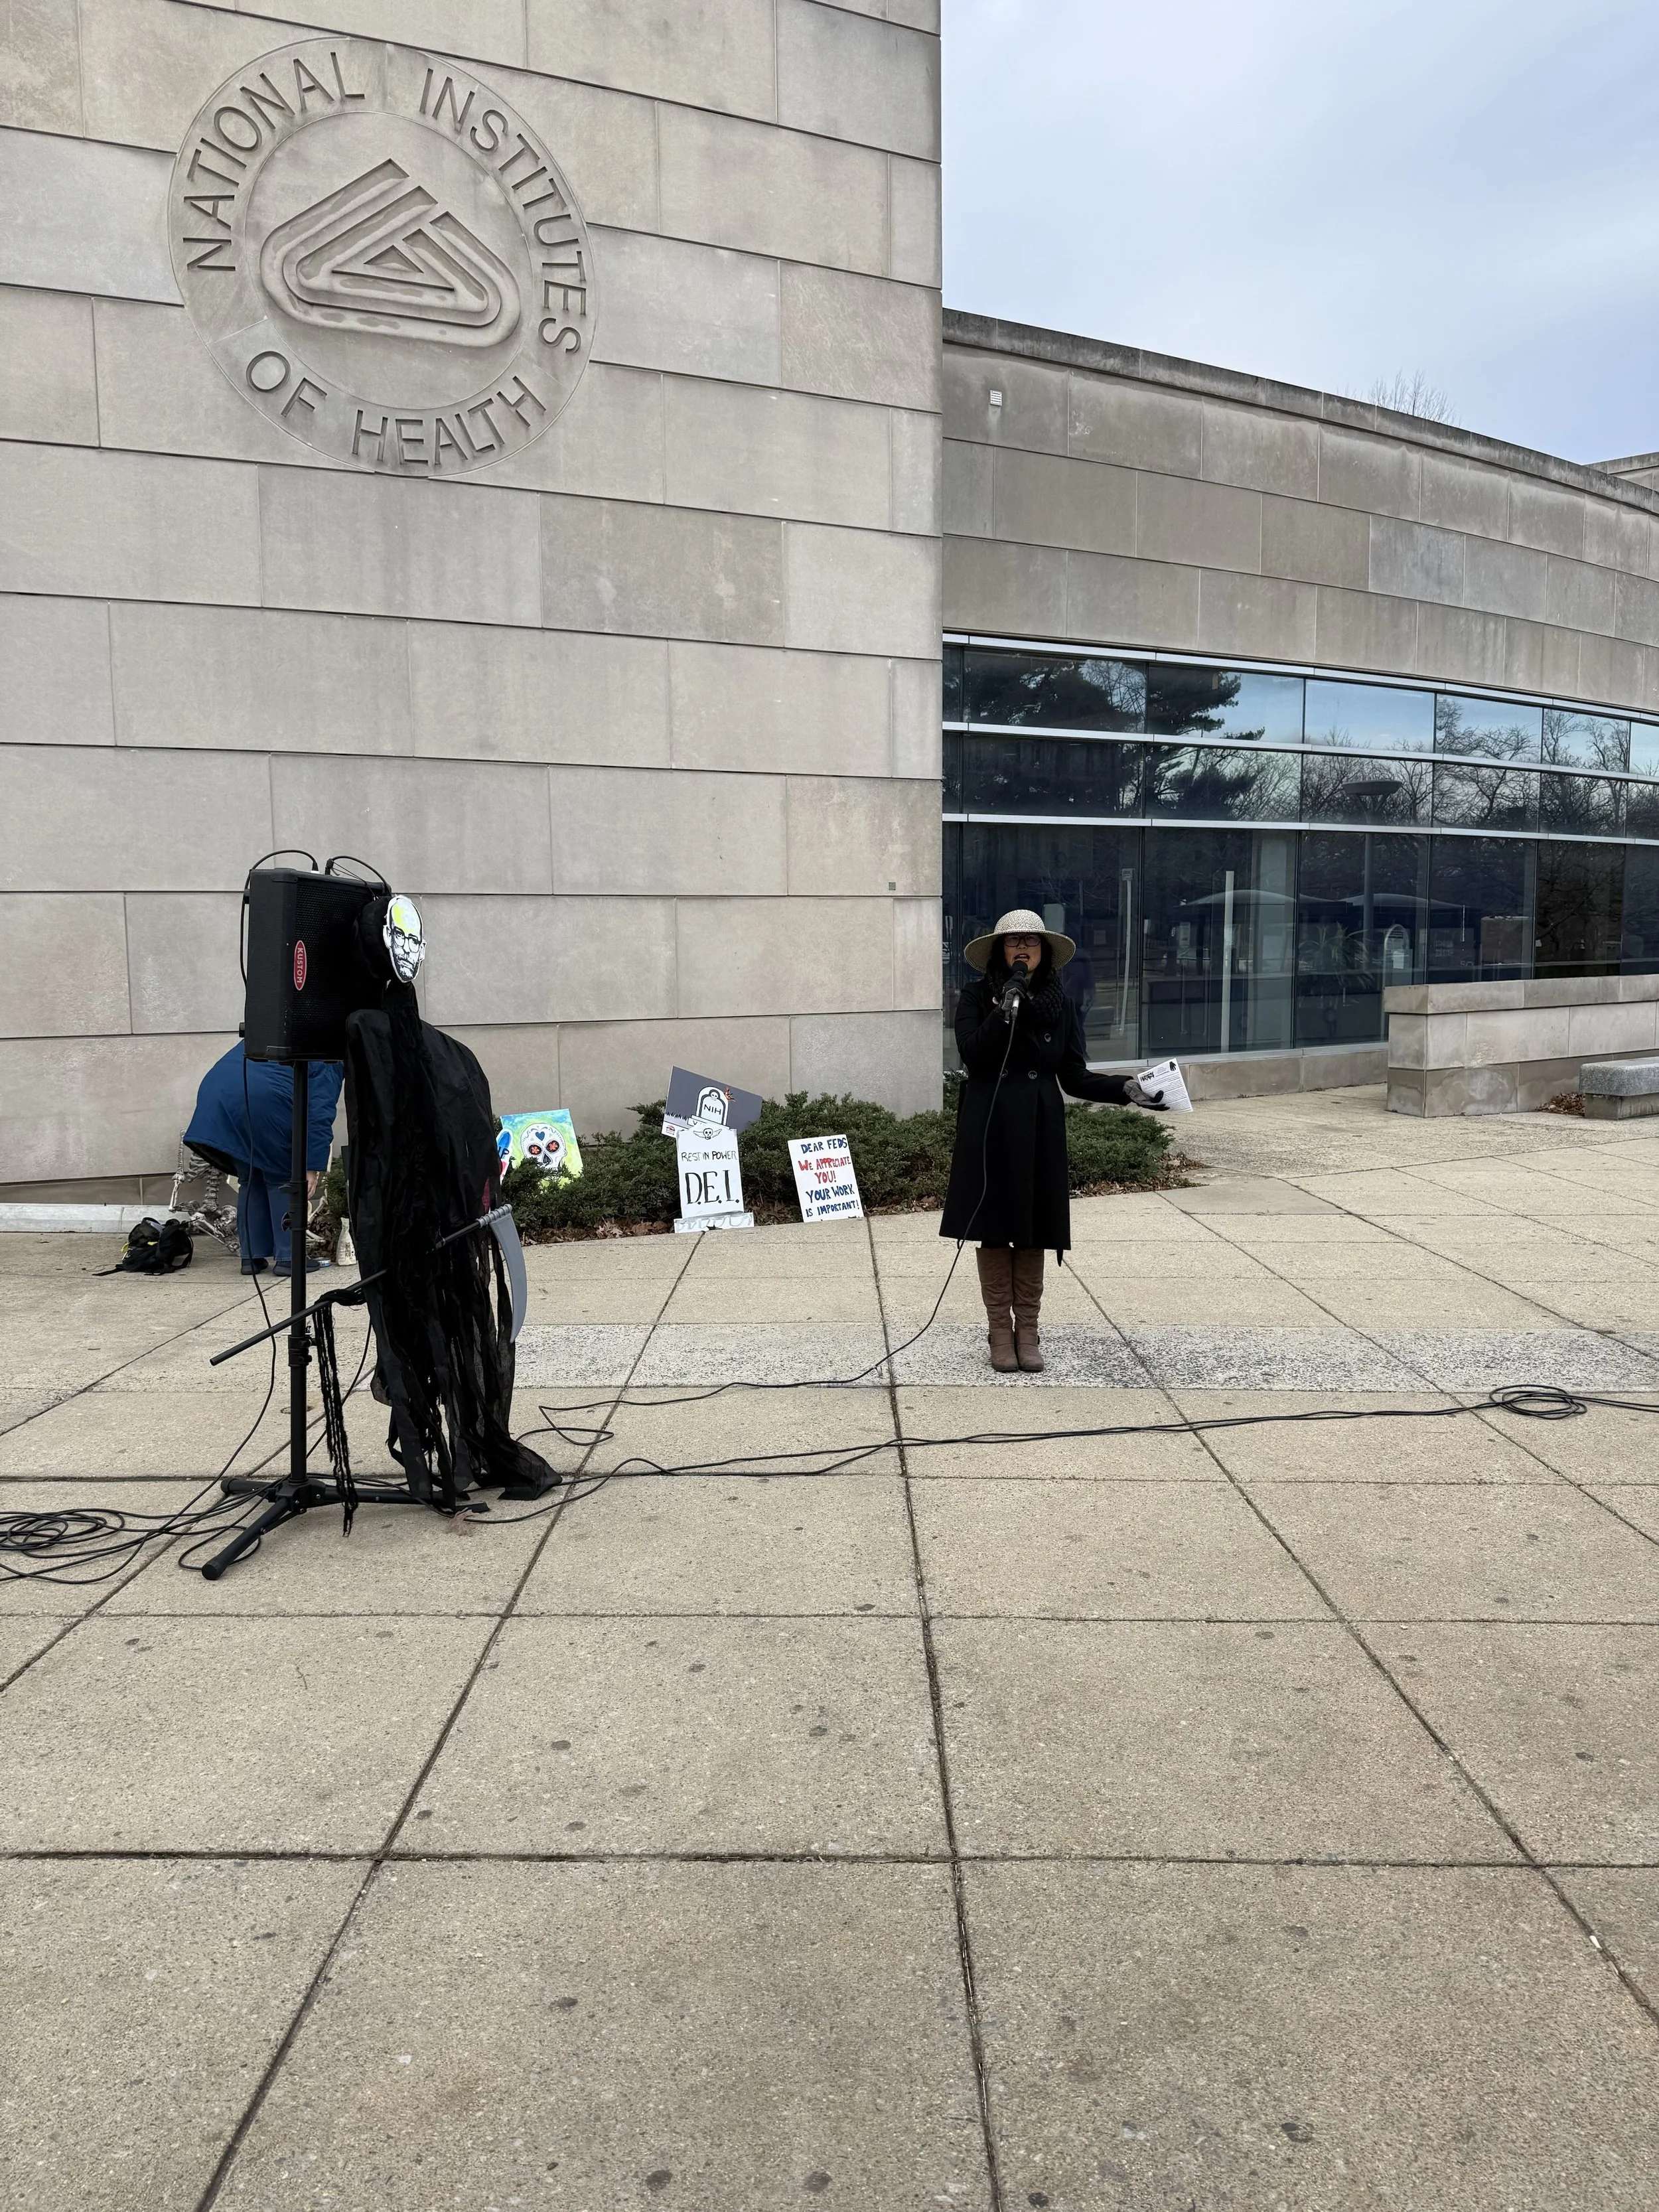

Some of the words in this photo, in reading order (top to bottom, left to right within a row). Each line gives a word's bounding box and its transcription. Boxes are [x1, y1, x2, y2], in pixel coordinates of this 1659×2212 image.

[182, 51, 366, 272] NATIONAL
[419, 67, 587, 355] INSTITUTES
[246, 350, 328, 418] OF
[351, 374, 547, 466] HEALTH
[703, 1104, 721, 1115] NIH
[800, 1141, 824, 1154] DEAR
[826, 1137, 847, 1149] FEDS
[681, 1151, 701, 1161] REST
[703, 1151, 709, 1160] IN
[711, 1150, 737, 1161] POWER
[816, 1156, 851, 1170] APPRECIATE
[814, 1170, 837, 1184] YOU!
[685, 1169, 740, 1205] D.E.I.
[806, 1188, 831, 1203] YOUR
[831, 1183, 855, 1198] WORK
[805, 1209, 813, 1217] IS
[817, 1199, 860, 1216] IMPORTANT!
